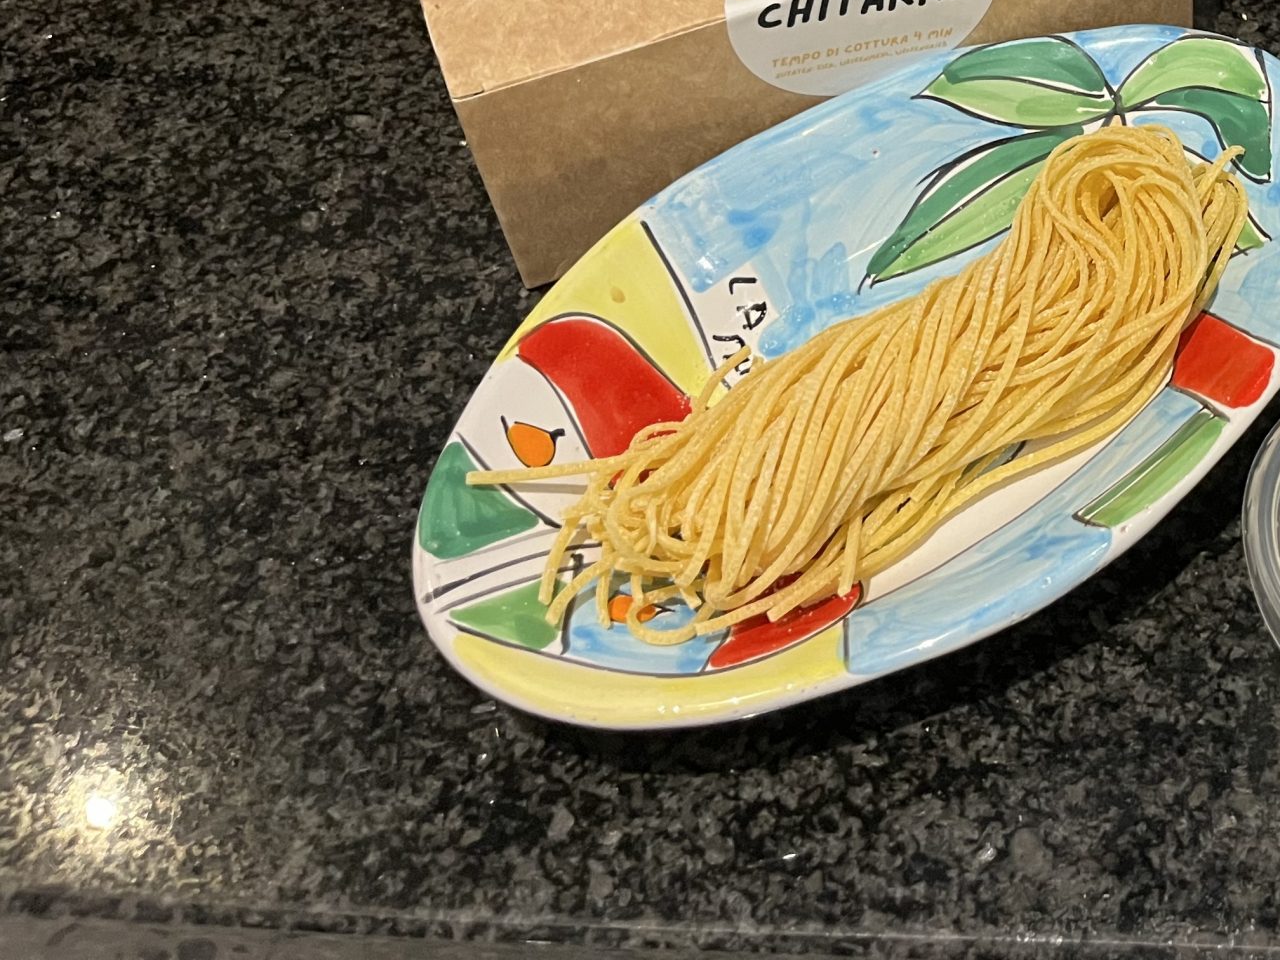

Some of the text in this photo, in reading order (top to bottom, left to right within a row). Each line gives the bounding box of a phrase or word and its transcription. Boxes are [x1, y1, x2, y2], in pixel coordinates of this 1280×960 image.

[772, 28, 953, 68] TEMPO DI COTTURA 4 MIN
